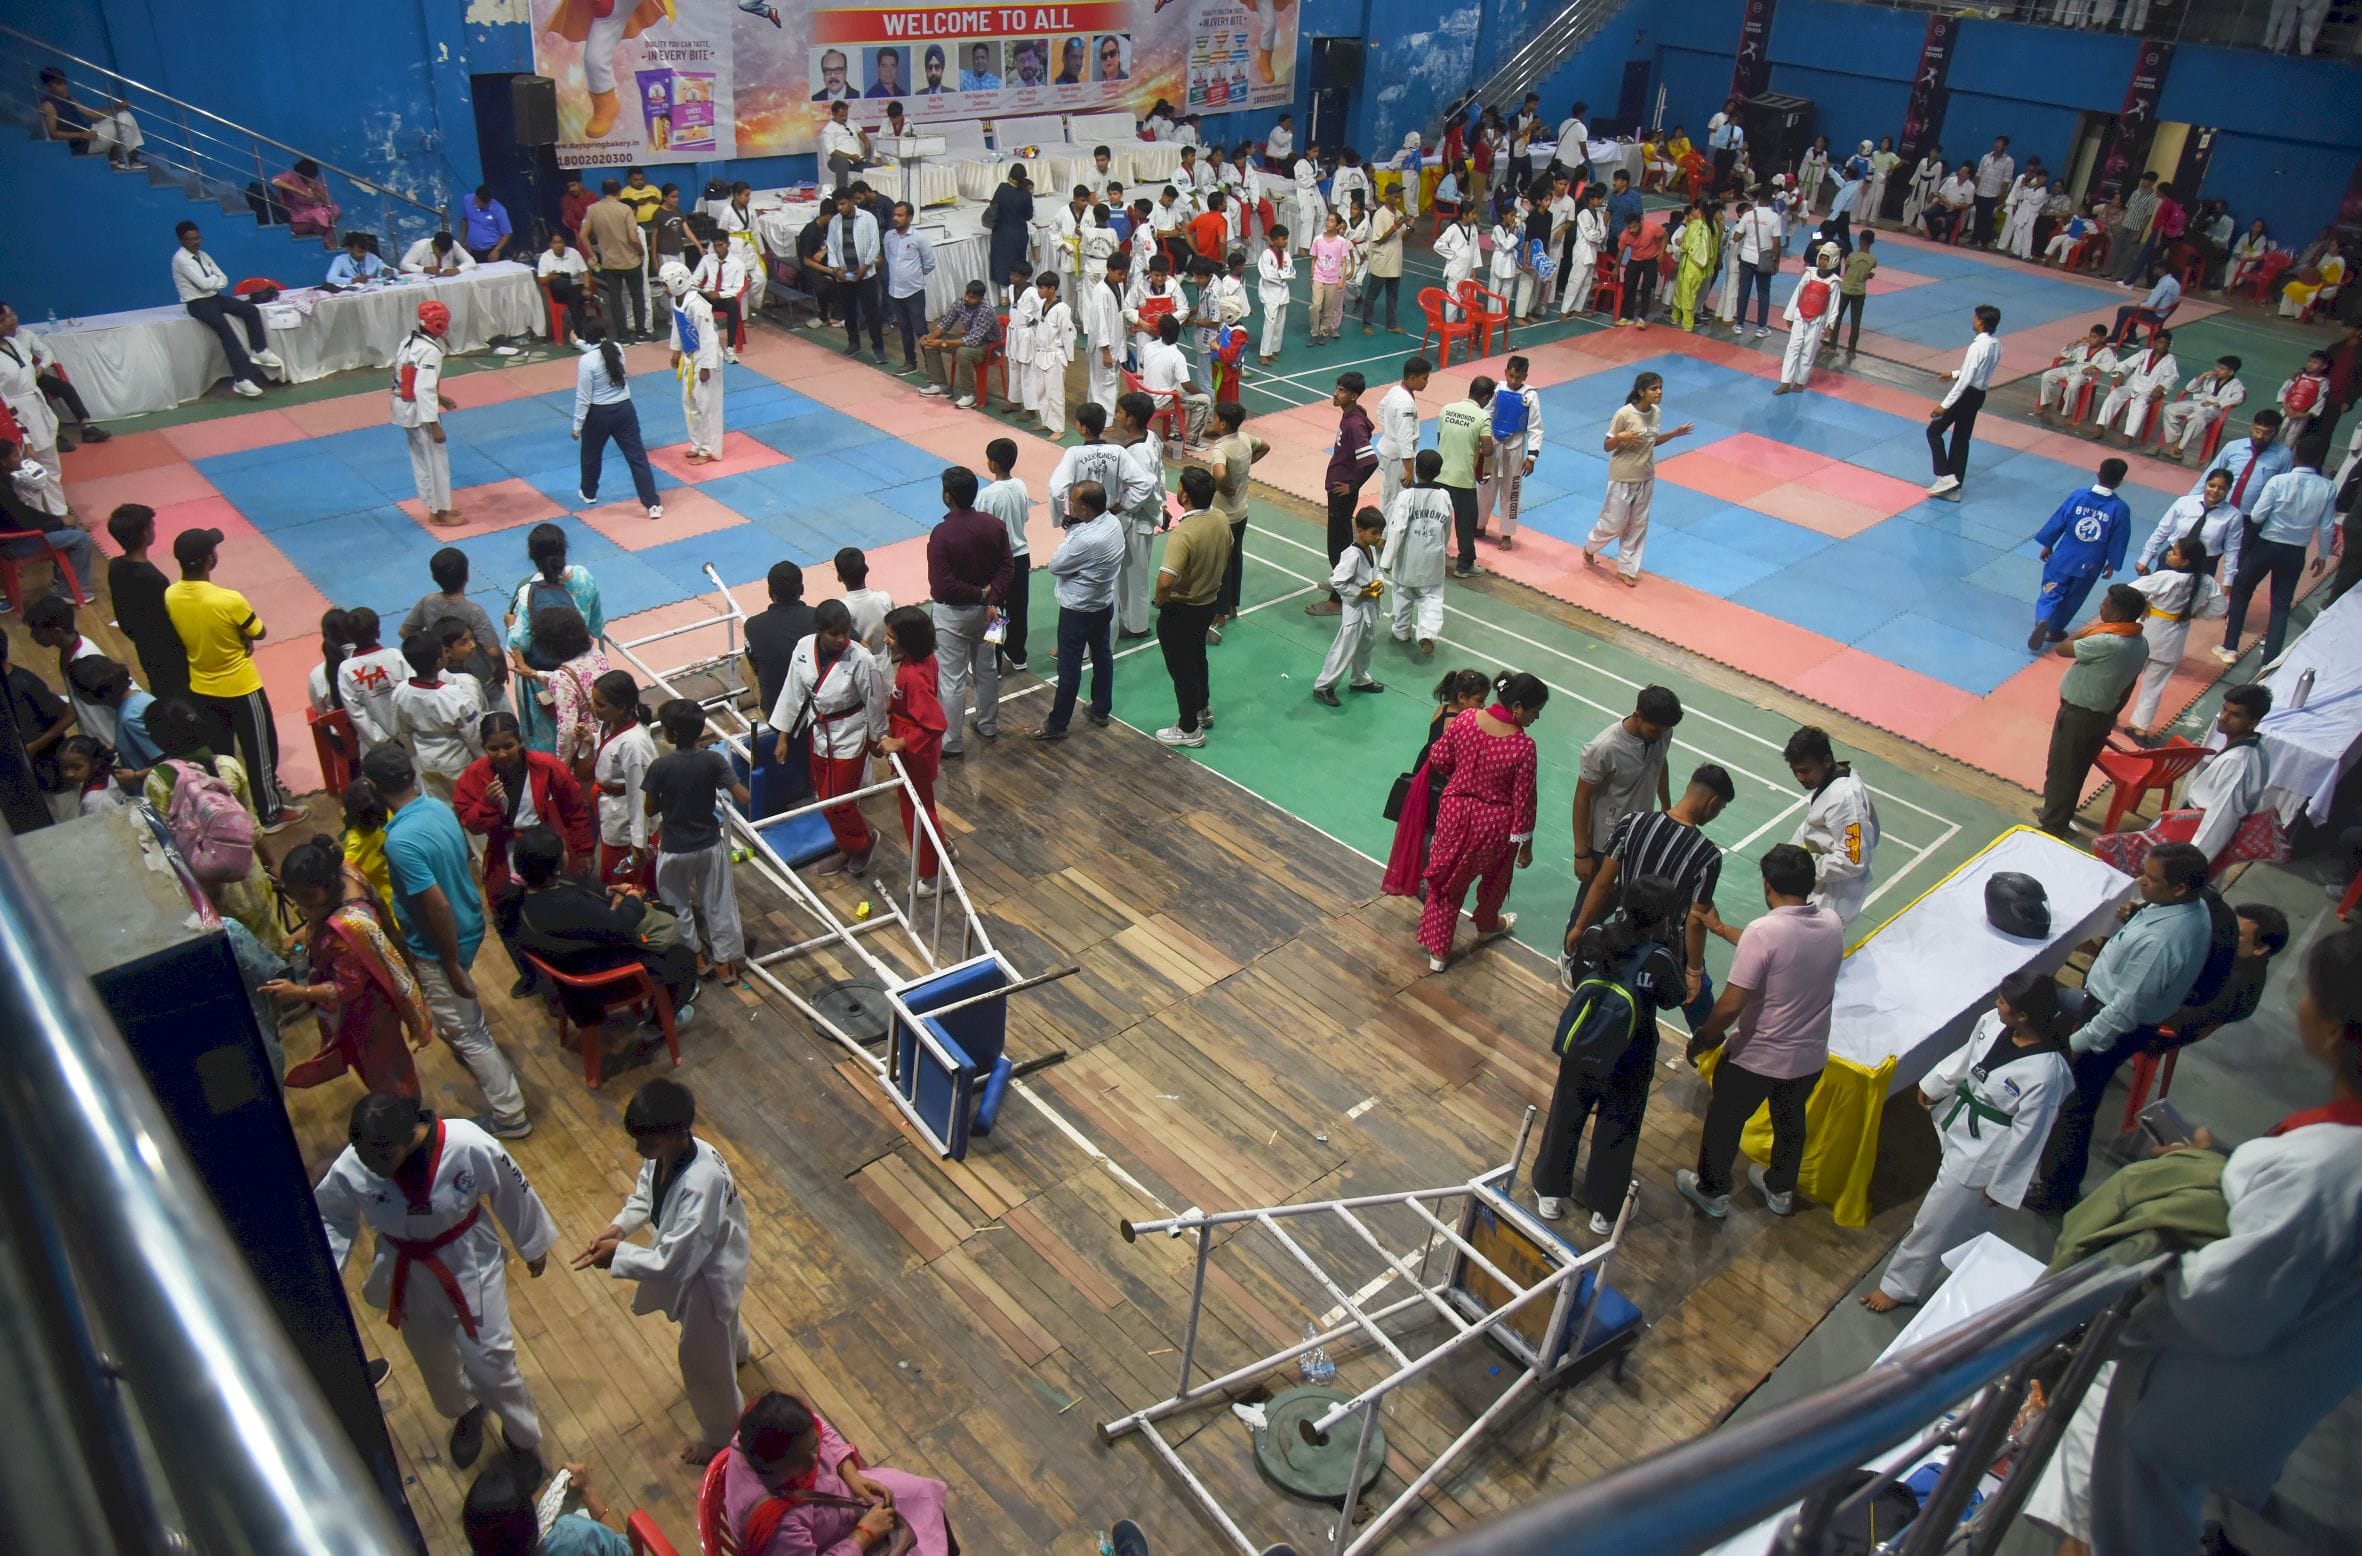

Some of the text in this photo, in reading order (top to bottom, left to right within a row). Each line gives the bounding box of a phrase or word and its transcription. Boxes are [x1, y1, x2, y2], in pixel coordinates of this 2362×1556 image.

[882, 8, 1075, 36] WELCOME TO ALL
[1210, 16, 1230, 26] EVERY
[1230, 15, 1243, 25] BITE
[648, 50, 709, 61] IN EVERY BITE
[558, 153, 633, 166] 18002020300
[1445, 410, 1475, 423] TAEKWONDO
[1445, 416, 1470, 428] COACH
[1079, 451, 1118, 465] TAEKWONDO
